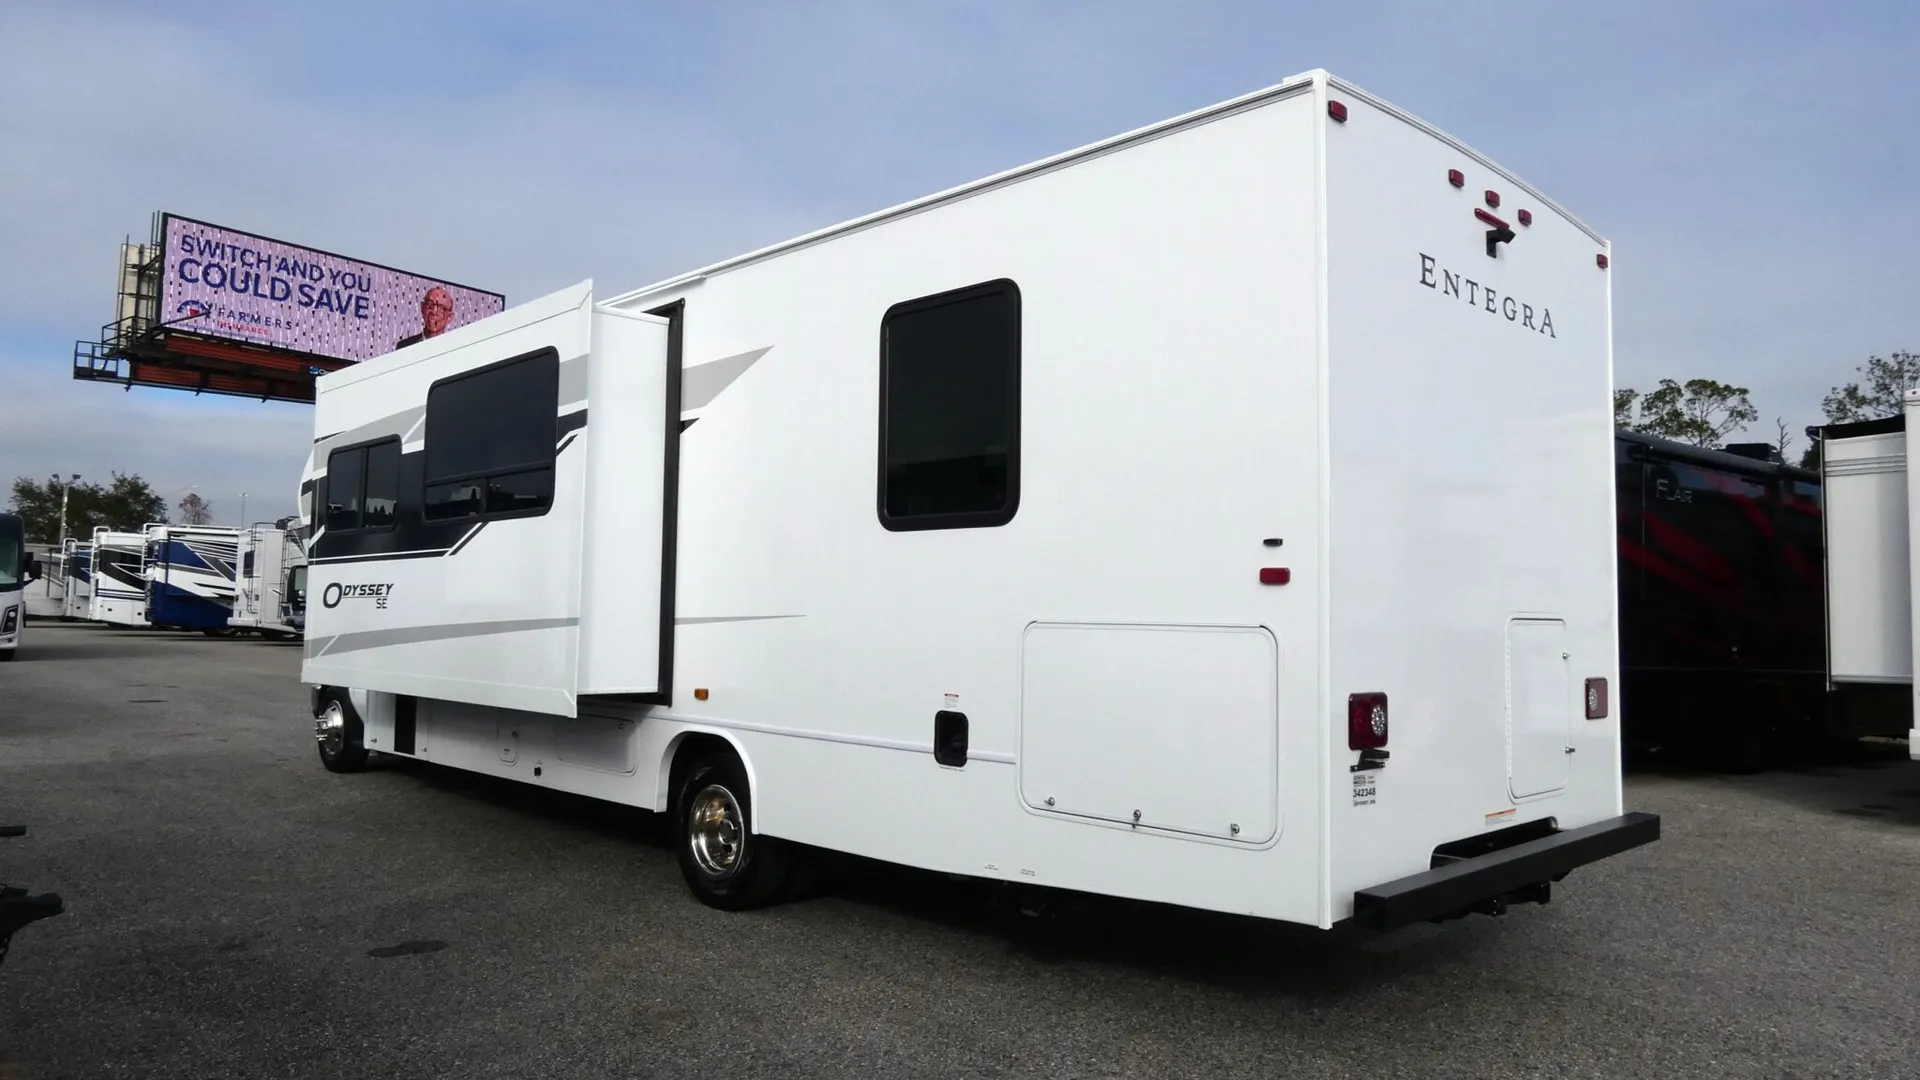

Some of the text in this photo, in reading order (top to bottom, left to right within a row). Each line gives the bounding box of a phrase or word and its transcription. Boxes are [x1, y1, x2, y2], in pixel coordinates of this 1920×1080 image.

[181, 234, 371, 292] SWITCH AND YOU
[179, 258, 370, 320] COULD SAVE
[1418, 252, 1556, 339] ENTEGRA
[218, 307, 292, 330] FARMERS
[322, 582, 394, 609] ODYSSEY
[376, 598, 388, 609] SE
[1353, 787, 1376, 798] 342348
